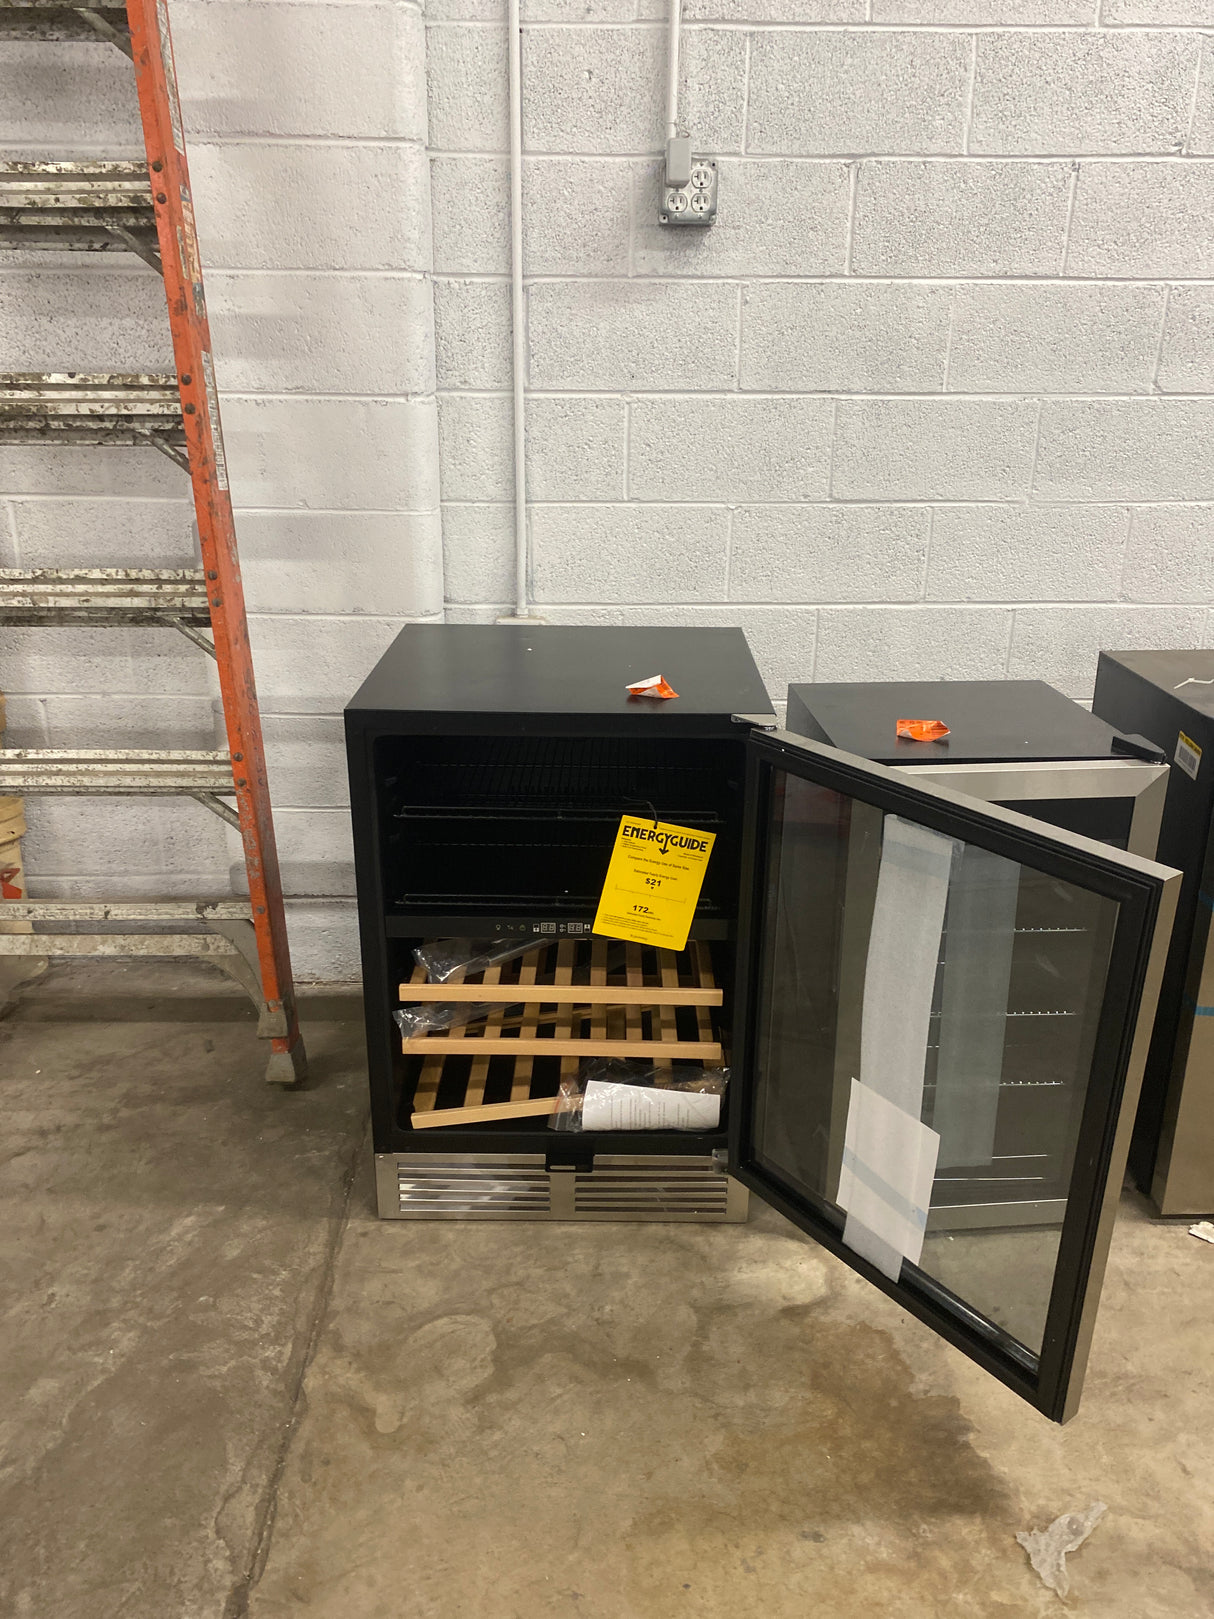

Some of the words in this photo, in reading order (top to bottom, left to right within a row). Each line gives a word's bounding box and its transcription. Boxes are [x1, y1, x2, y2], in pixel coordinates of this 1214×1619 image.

[622, 825, 709, 853] ENERGYGUIDE
[645, 878, 662, 887] $21
[632, 904, 649, 913] 172
